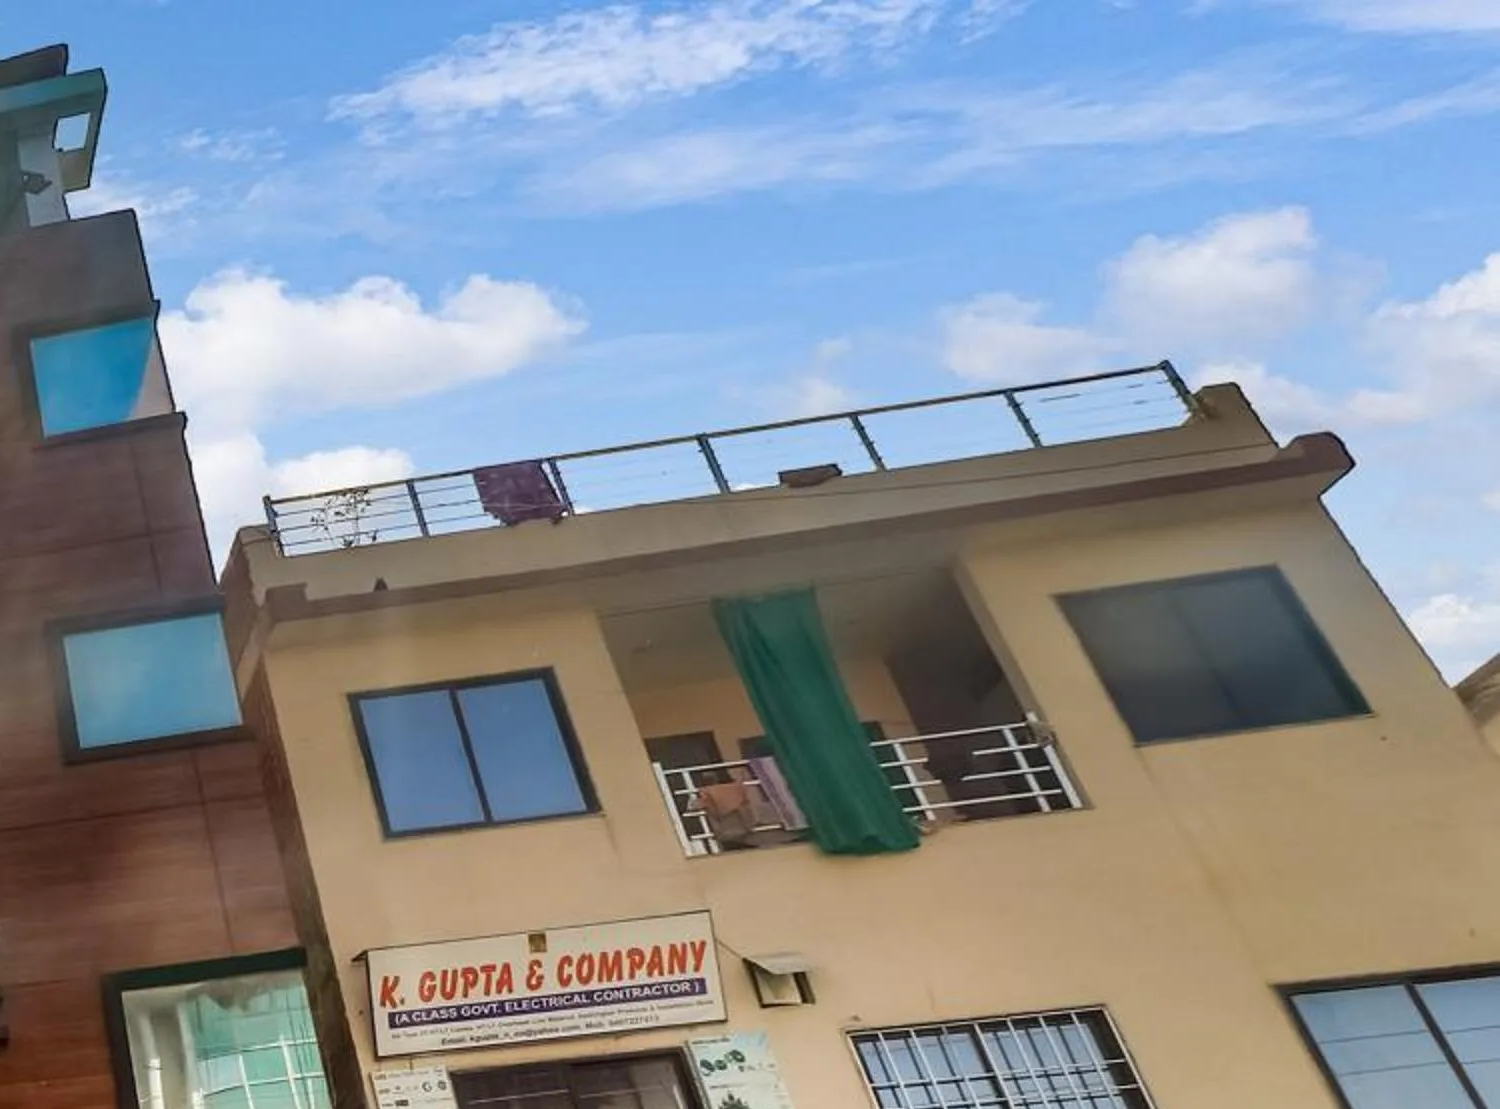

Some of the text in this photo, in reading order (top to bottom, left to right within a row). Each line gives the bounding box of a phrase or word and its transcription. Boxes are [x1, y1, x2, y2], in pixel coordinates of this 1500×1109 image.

[380, 940, 707, 1008] K. GUPTA & COMPANY
[412, 1007, 457, 1022] CLASS
[460, 1004, 501, 1017] GOVT.
[505, 994, 590, 1012] ELECTRICAL
[593, 983, 691, 1002] CONTRACTOR
